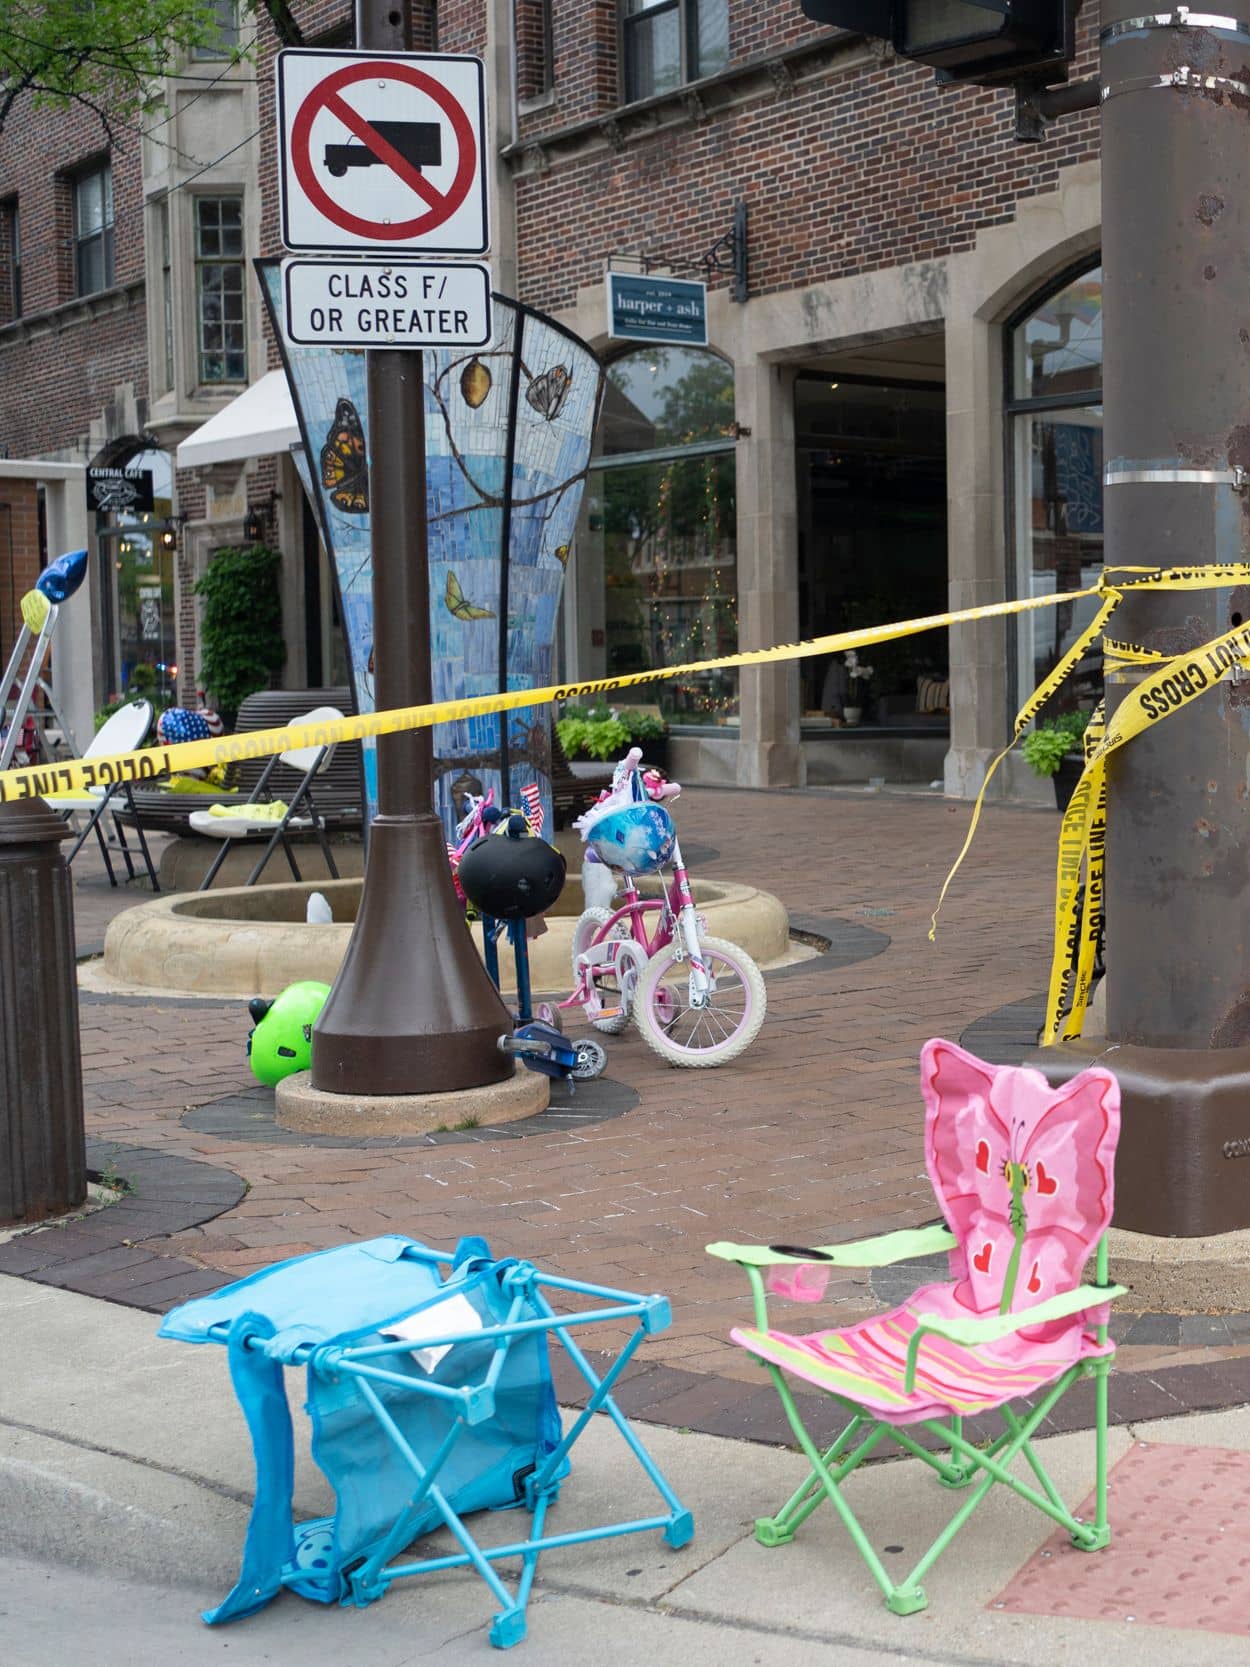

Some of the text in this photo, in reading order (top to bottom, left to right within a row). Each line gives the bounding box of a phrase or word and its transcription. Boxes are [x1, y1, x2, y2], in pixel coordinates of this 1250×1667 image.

[328, 274, 447, 299] CLASS F/
[617, 293, 663, 316] harper
[676, 301, 700, 317] ash
[310, 308, 468, 334] OR GREATER
[89, 467, 123, 478] CENTRAL
[1139, 663, 1208, 720] CROSS
[16, 769, 73, 799] LINE
[82, 753, 171, 789] POLICE
